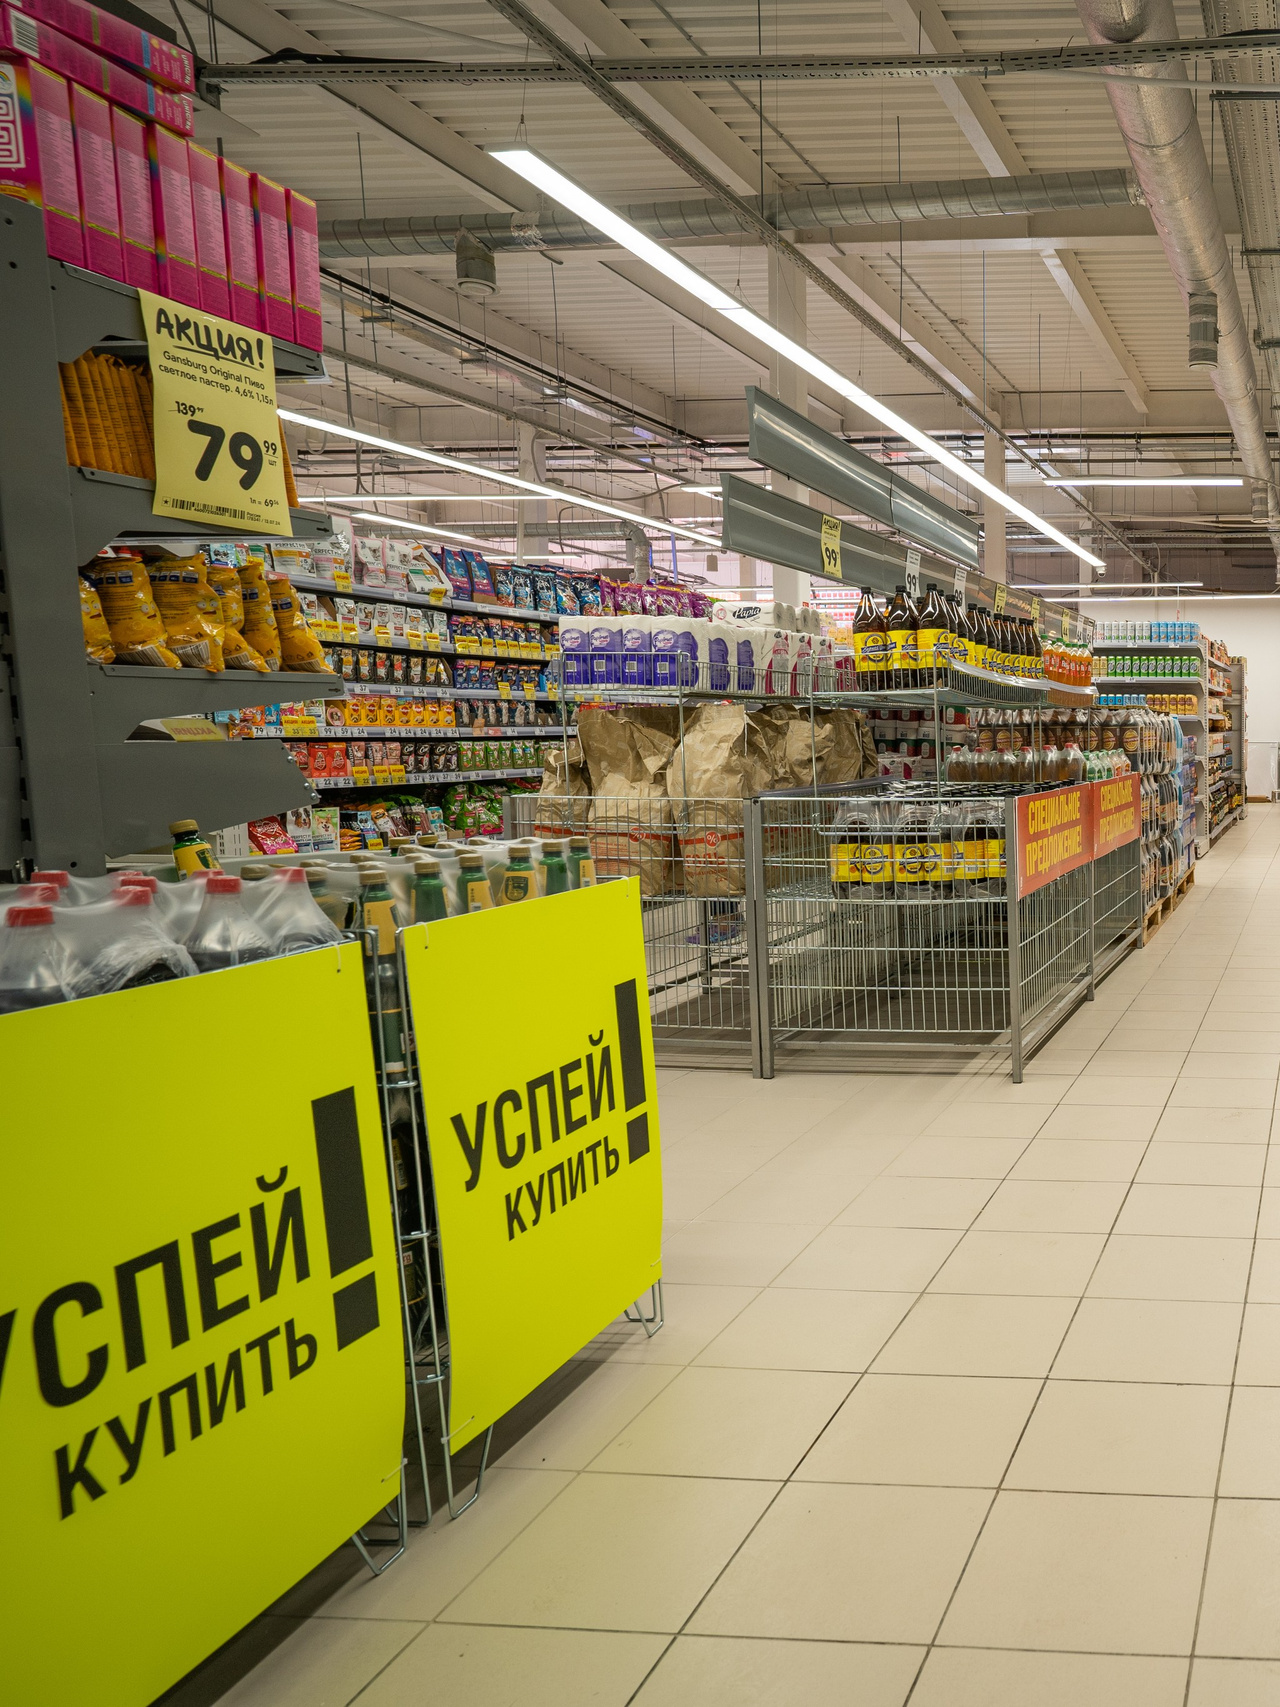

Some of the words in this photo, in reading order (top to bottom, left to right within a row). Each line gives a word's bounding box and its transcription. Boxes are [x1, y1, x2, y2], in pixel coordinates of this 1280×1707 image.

[156, 307, 264, 369] АКЦИЯ!
[158, 364, 197, 382] светлое
[199, 376, 233, 394] пастер.
[235, 386, 255, 400] 4,6%
[256, 391, 274, 406] 1,15л
[163, 350, 208, 374] Gansburg
[209, 365, 243, 383] Original
[244, 376, 265, 391] Пиво
[175, 400, 196, 417] 139
[187, 418, 263, 491] 79
[263, 440, 277, 455] 99
[268, 459, 277, 467] шт
[264, 498, 274, 508] 69
[823, 517, 841, 531] АКЦИЯ!
[825, 546, 838, 568] 99
[907, 572, 917, 592] 99
[734, 606, 762, 619] Papia
[1028, 790, 1081, 835] СПЕЦИАЛЬНОЕ
[1026, 824, 1083, 876] ПРЕДЛОЖЕНИЕ!
[450, 1029, 616, 1191] УСПЕЙ
[504, 1135, 620, 1241] КУПИТЬ
[54, 1308, 318, 1521] КУПИТЬ
